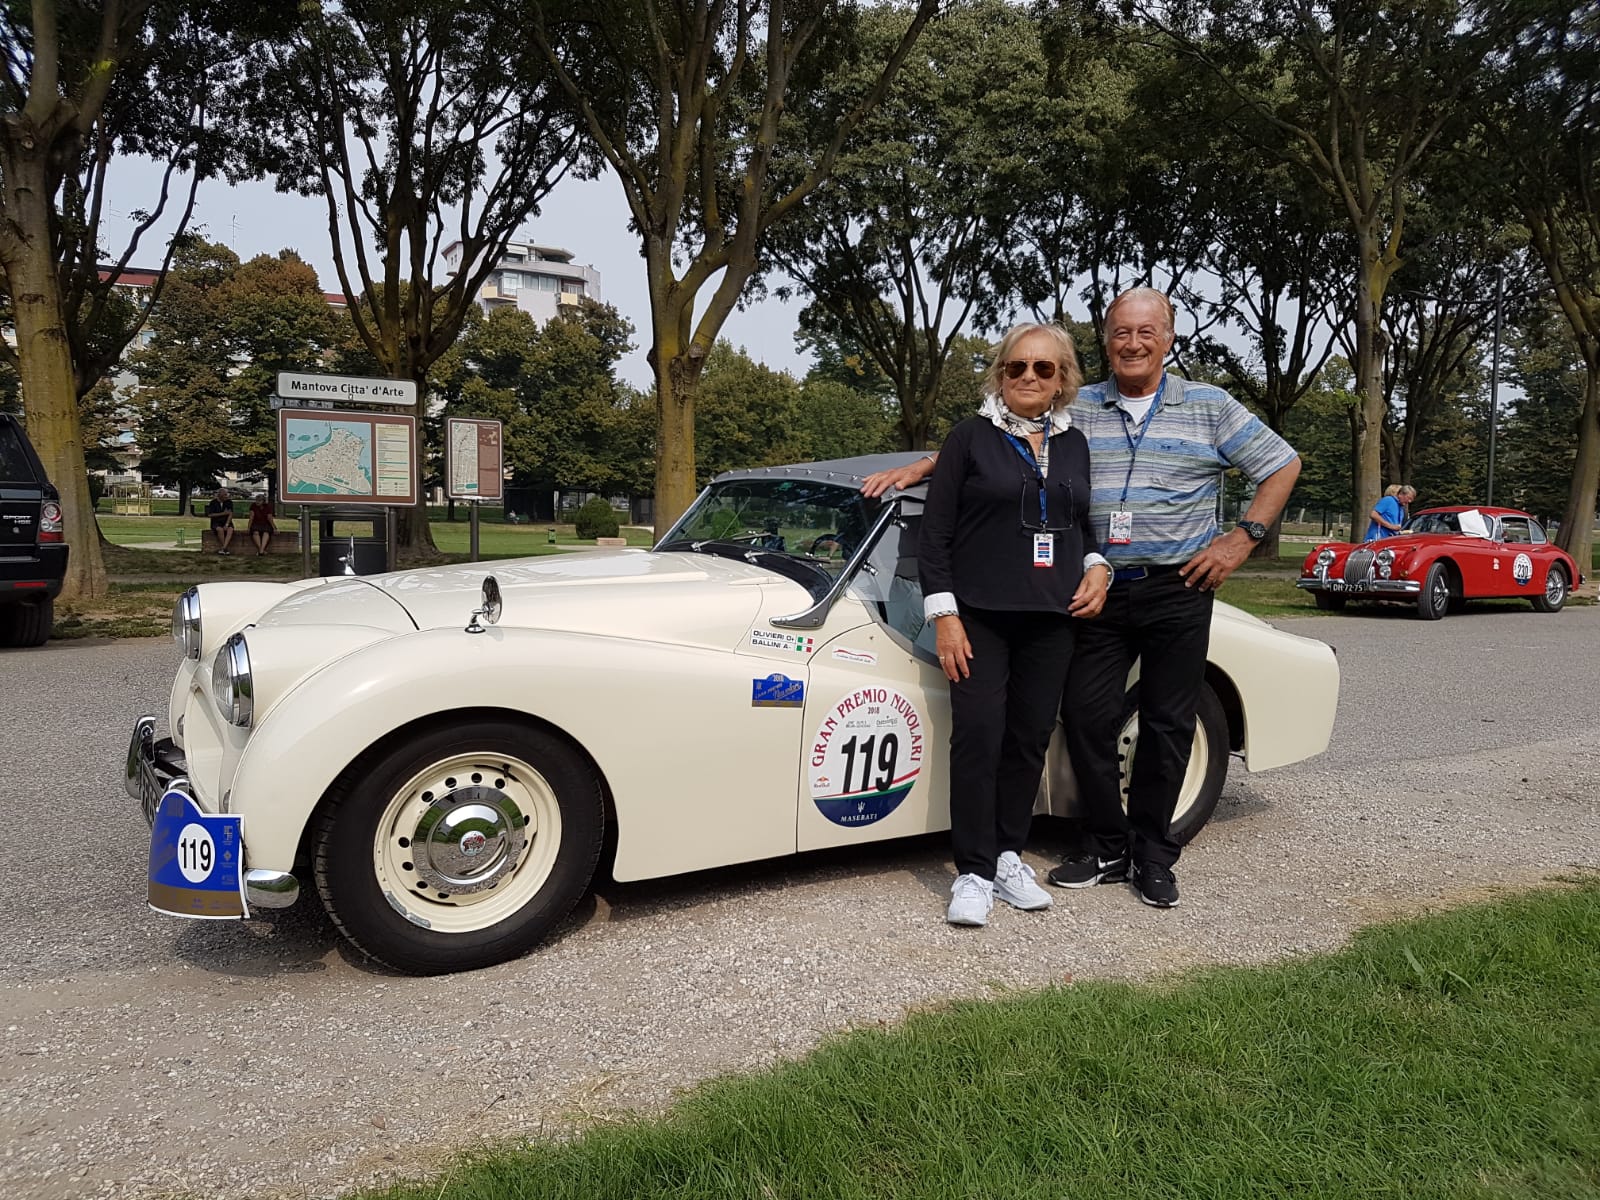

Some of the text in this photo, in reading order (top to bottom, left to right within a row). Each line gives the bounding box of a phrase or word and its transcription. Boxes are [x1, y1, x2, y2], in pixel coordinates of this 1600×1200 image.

[291, 380, 405, 397] Mantova Citta' d'Arte
[753, 630, 785, 640] OLIVIERI
[752, 638, 781, 648] BALLINI
[867, 706, 880, 715] 2018
[811, 688, 921, 767] GRAN PREMIO NUVOLARI
[841, 732, 899, 794] 119
[840, 813, 878, 823] MASERATI
[180, 837, 212, 872] 119
